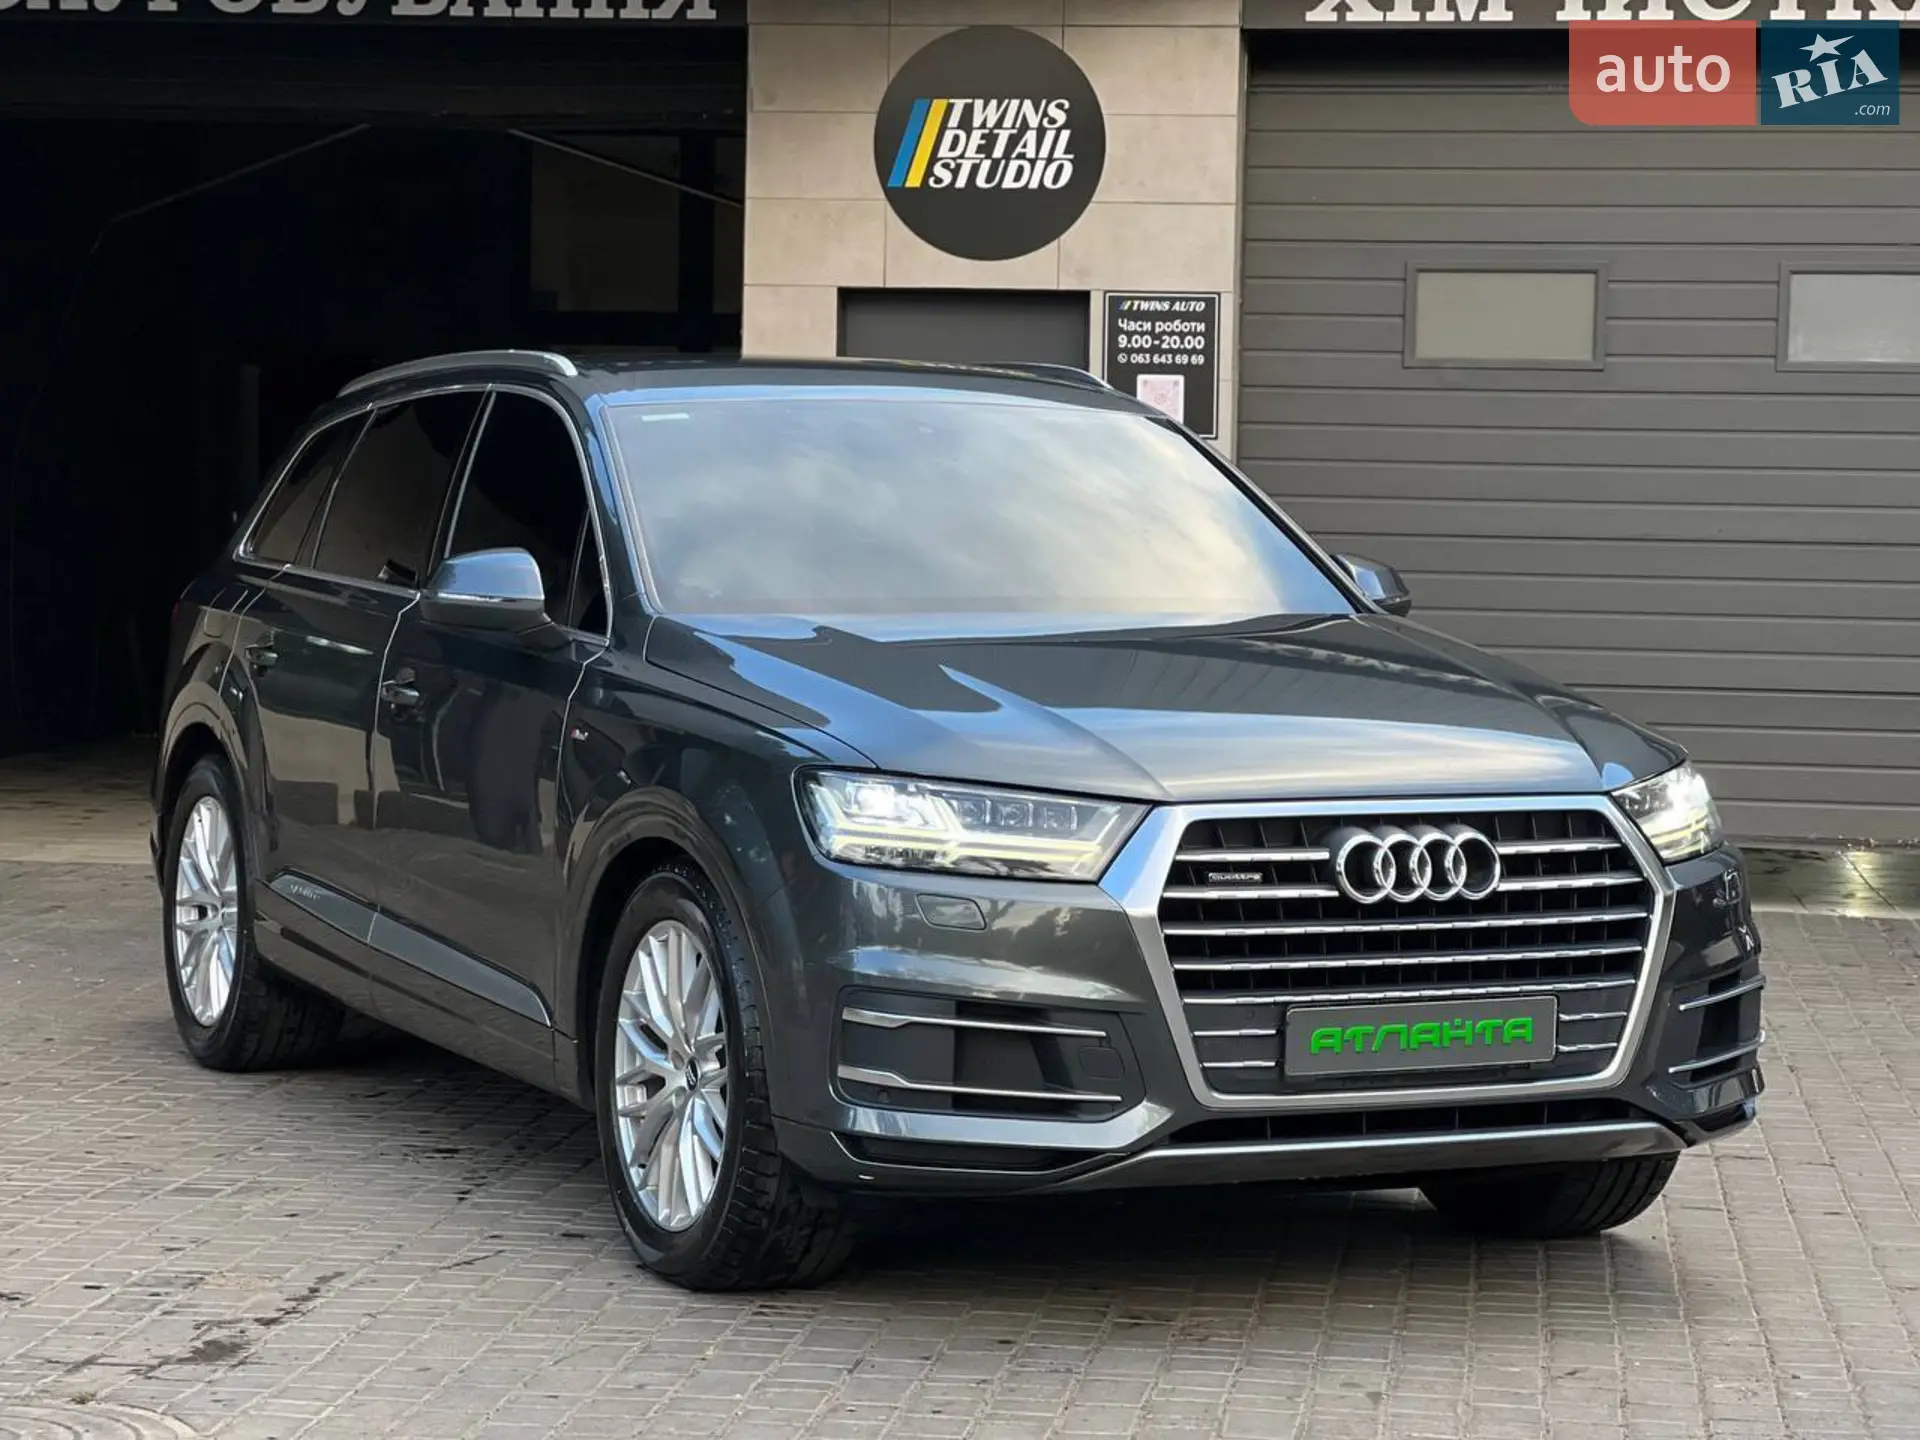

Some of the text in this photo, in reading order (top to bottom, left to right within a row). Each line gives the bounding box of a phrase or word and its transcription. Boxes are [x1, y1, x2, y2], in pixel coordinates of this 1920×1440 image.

[946, 98, 1070, 129] TWINS
[936, 128, 1075, 160] DETAIL
[928, 158, 1074, 190] STUDIO
[1132, 299, 1206, 313] TWINS AUTO
[1117, 317, 1206, 334] Часи роботи
[1129, 352, 1206, 366] 063 643 69 69
